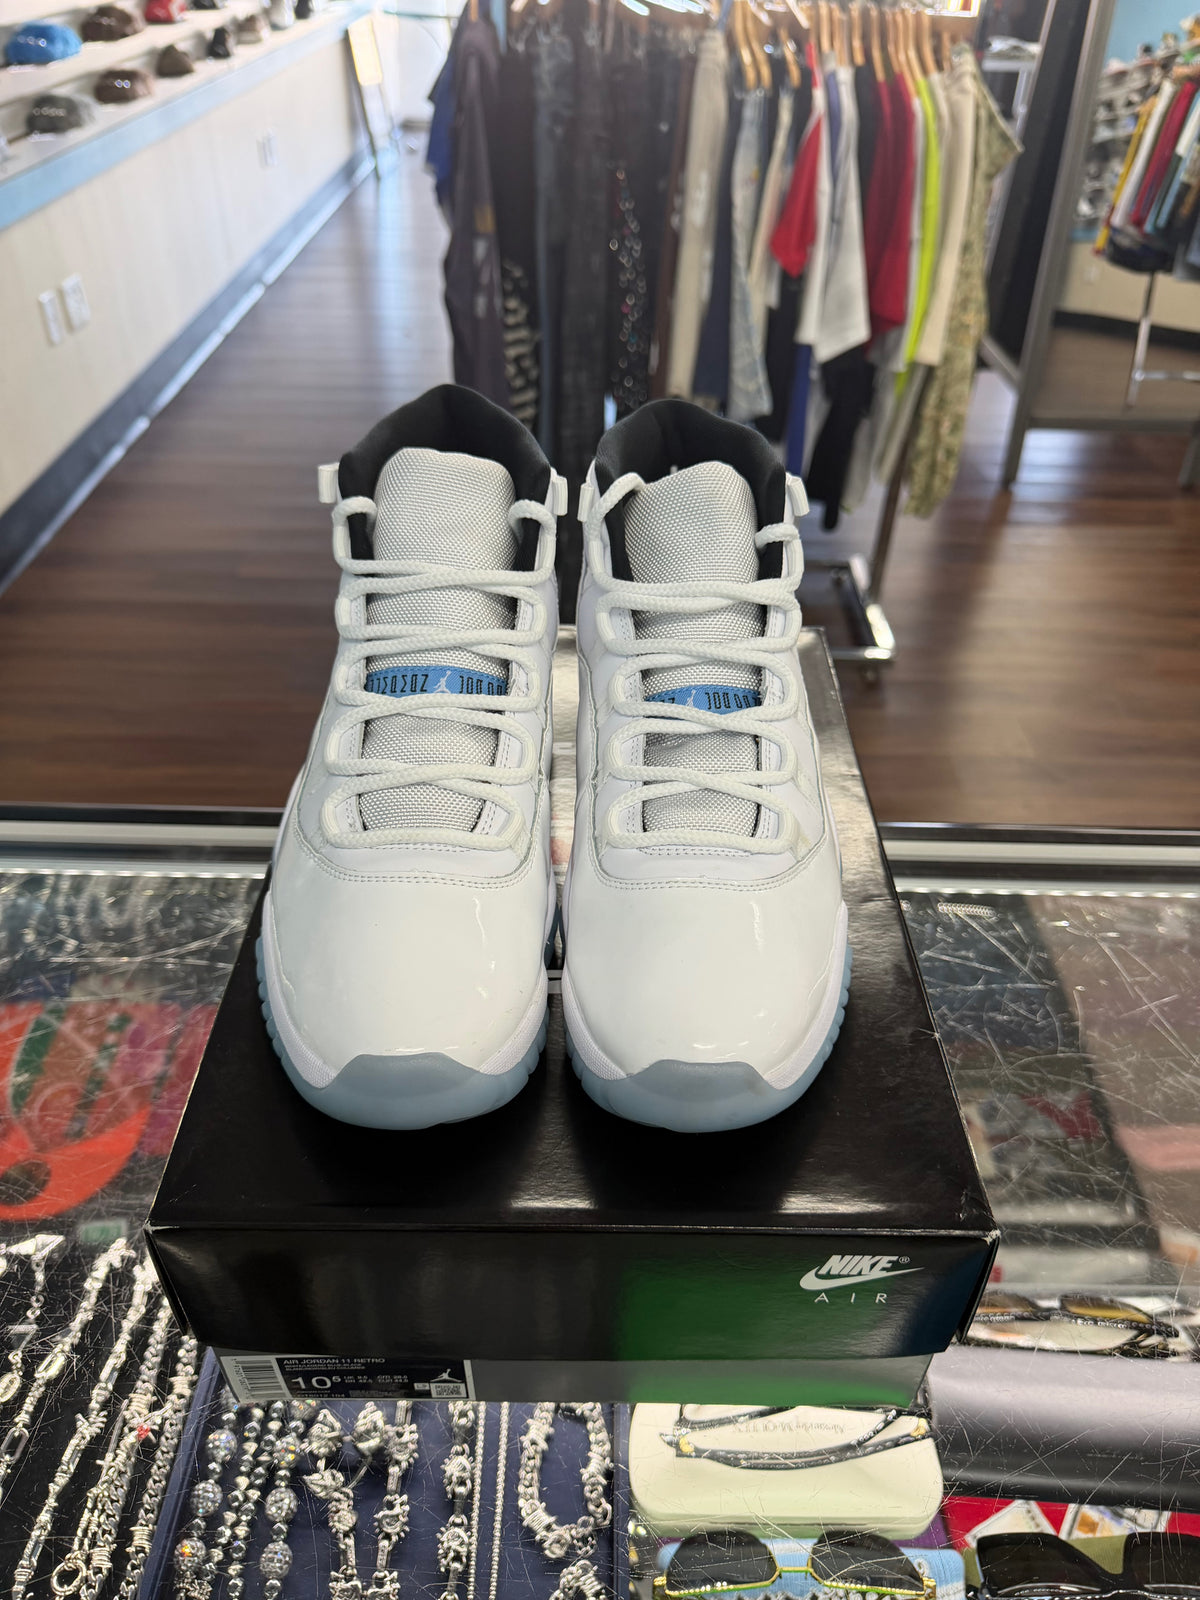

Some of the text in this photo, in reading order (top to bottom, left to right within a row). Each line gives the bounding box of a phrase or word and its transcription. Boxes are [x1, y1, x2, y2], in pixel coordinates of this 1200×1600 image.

[817, 1254, 899, 1276] NIKE
[814, 1292, 887, 1304] AIR
[291, 1376, 332, 1390] 10
